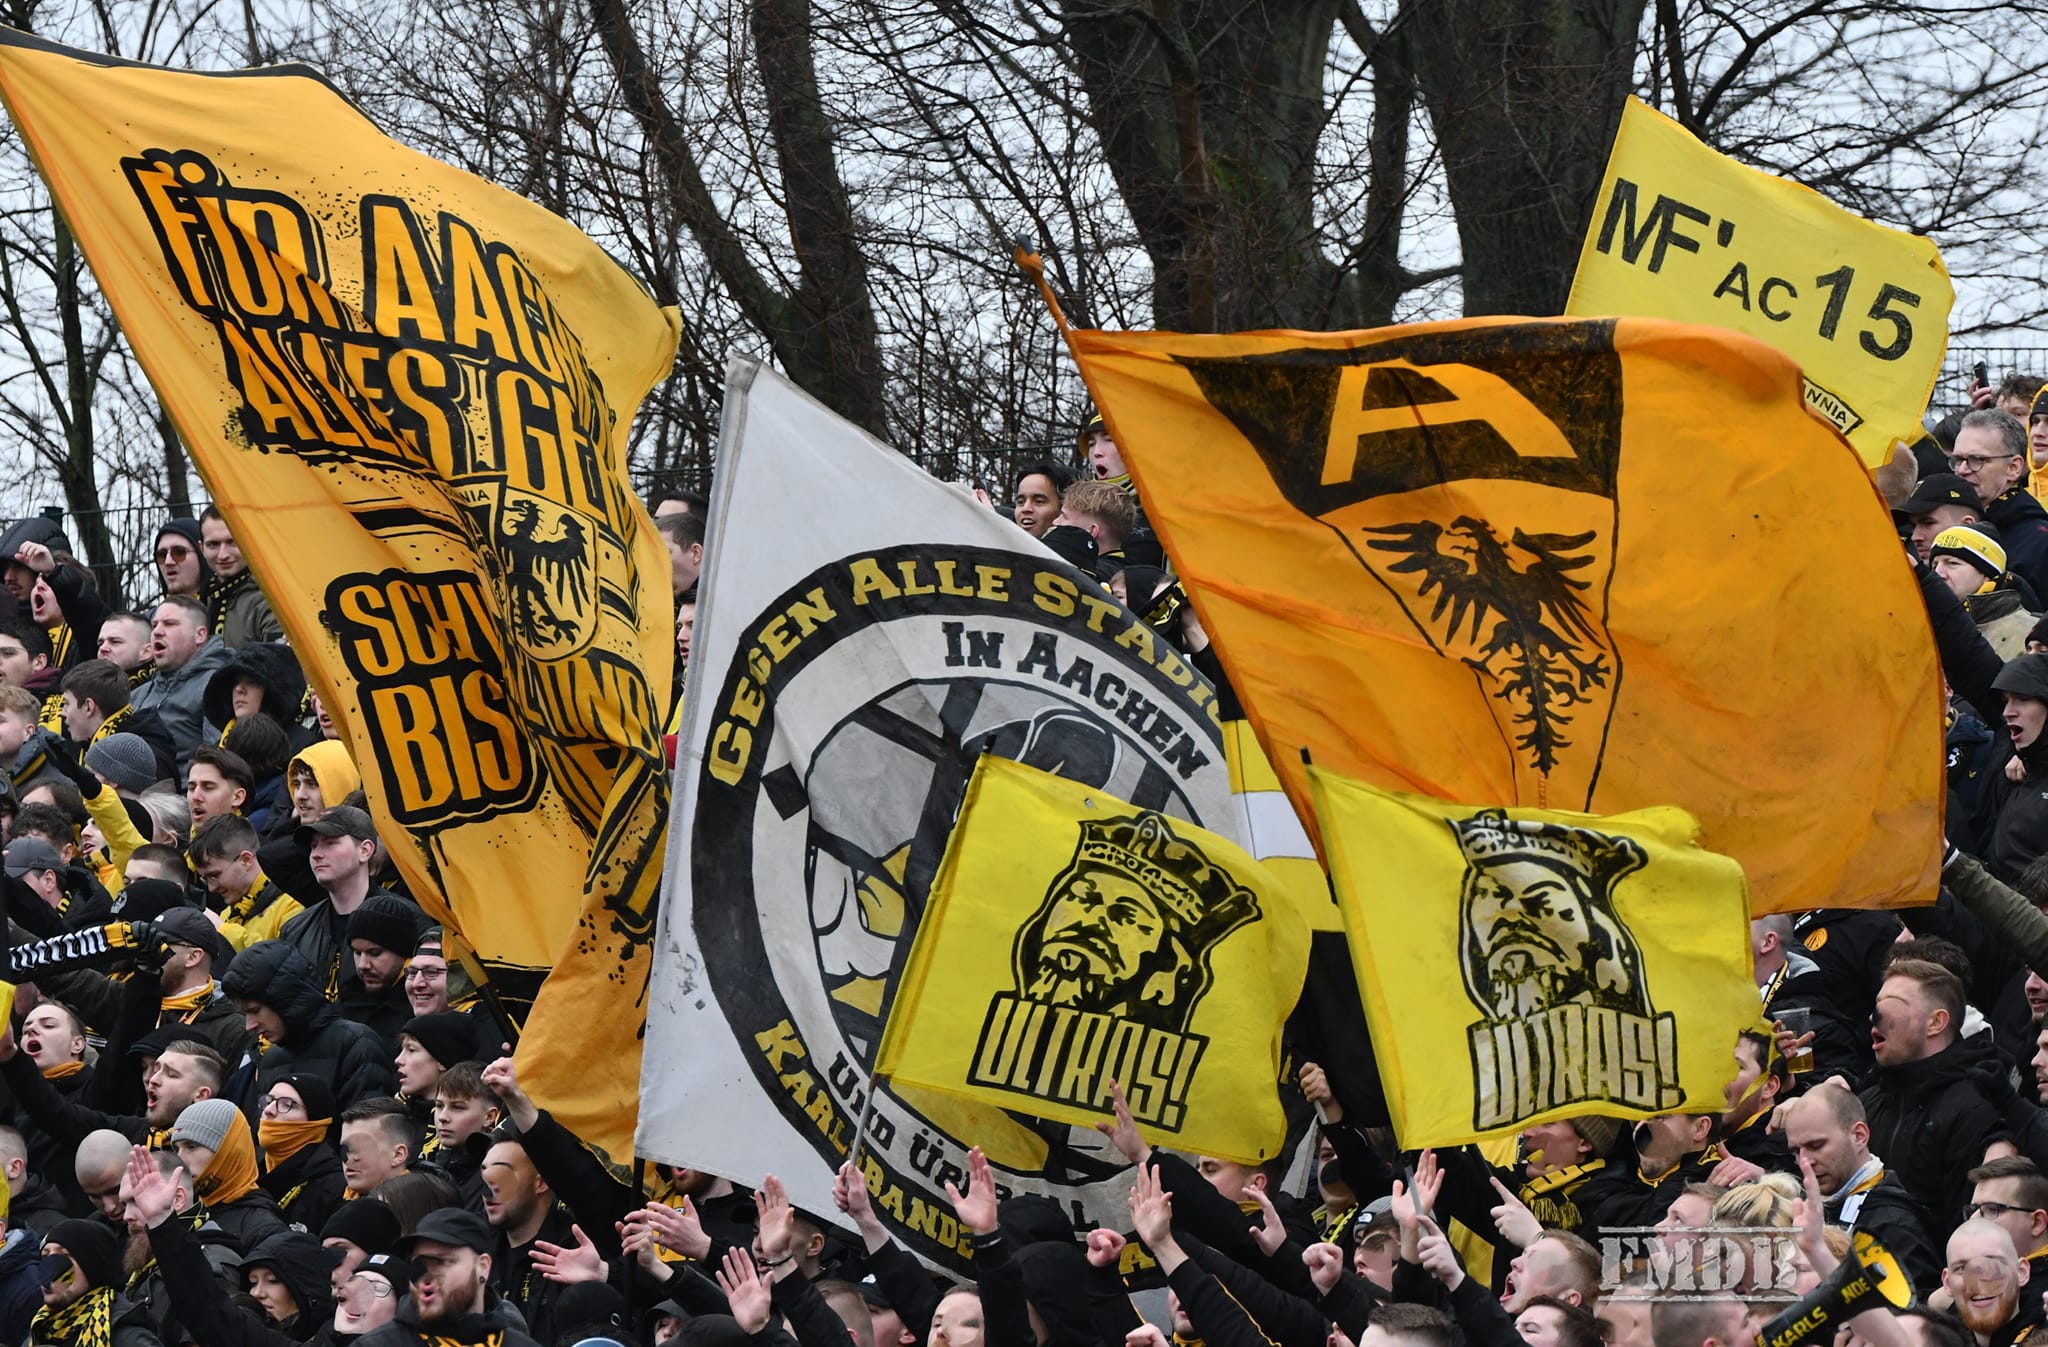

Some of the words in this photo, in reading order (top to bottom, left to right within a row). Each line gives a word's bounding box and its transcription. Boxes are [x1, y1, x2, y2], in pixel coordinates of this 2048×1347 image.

[1713, 262, 1799, 322] AC
[1815, 265, 1922, 361] 15
[1320, 357, 1579, 487] A
[1804, 385, 1848, 424] NNIA
[708, 587, 838, 787] GEGEN
[849, 557, 1012, 606] ALLE
[942, 621, 1005, 669] IN
[1016, 631, 1211, 781] AACHEN
[371, 668, 524, 812] BIS
[828, 1051, 897, 1151] UND
[973, 995, 1204, 1130] ULTRAS!
[1473, 1004, 1683, 1128] ULTRAS!
[1771, 1305, 1829, 1347] KARLS
